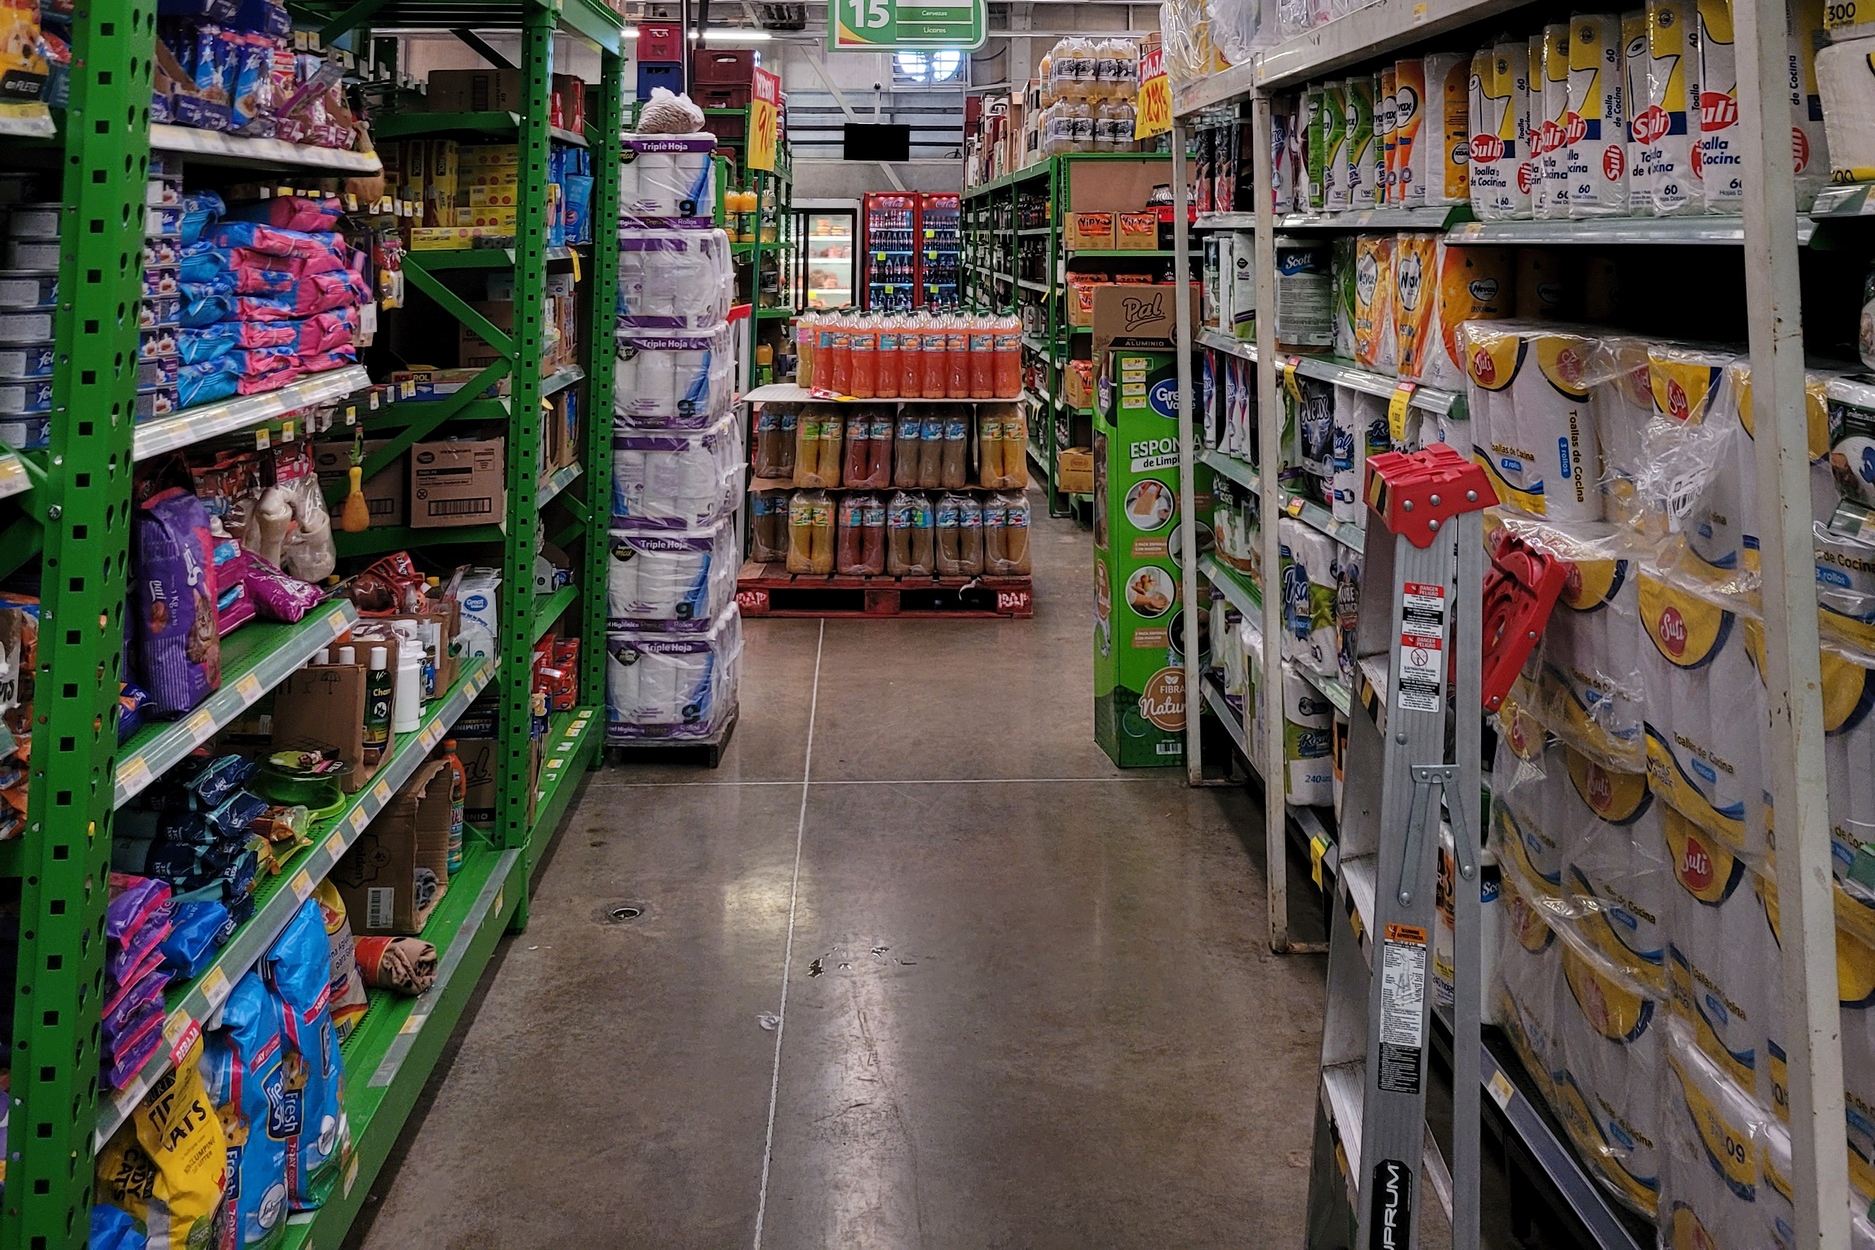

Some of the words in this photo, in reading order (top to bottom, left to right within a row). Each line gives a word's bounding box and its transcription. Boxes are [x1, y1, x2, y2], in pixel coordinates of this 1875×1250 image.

[1827, 1, 1856, 22] 300
[1606, 48, 1616, 63] 60
[1789, 54, 1797, 90] Cocina
[1605, 94, 1613, 119] Toalla
[1613, 86, 1622, 114] Cocina
[1691, 83, 1699, 111] Toalla
[1568, 118, 1583, 138] uli
[1614, 116, 1622, 128] de
[642, 142, 667, 151] Triple
[668, 142, 689, 152] Hoja
[1606, 148, 1620, 180] Suli
[1632, 164, 1645, 177] de
[1578, 184, 1591, 194] 60
[1663, 184, 1678, 195] 60
[678, 200, 696, 218] 9
[1284, 253, 1312, 271] Scott
[642, 339, 667, 349] Triple
[668, 339, 688, 350] Hoja
[1125, 339, 1165, 348] ALUMINIO
[1474, 351, 1494, 376] Suli
[1155, 387, 1196, 402] Gret
[1667, 386, 1687, 413] Suli
[1569, 410, 1579, 448] Toallas
[1143, 458, 1155, 468] de
[1510, 447, 1517, 456] de
[1516, 448, 1536, 463] Cocina
[1561, 451, 1570, 473] rollos
[1573, 450, 1581, 464] de
[1573, 466, 1585, 503] Cocina
[641, 539, 666, 550] Triple
[667, 539, 688, 550] Hoja
[1823, 550, 1835, 564] de
[1837, 553, 1875, 573] Cocina
[1824, 569, 1846, 584] rollos
[675, 602, 693, 621] 9
[1660, 616, 1685, 642] Suli
[672, 643, 693, 654] Hoja
[1159, 685, 1186, 694] FIBRA
[681, 704, 701, 724] 9
[1708, 748, 1735, 775] Cocina
[1304, 774, 1322, 784] 240
[1682, 853, 1708, 876] Suli
[1482, 881, 1500, 896] Sco
[176, 1027, 200, 1063] REBAJA
[283, 1092, 299, 1132] Fresh
[288, 1142, 297, 1168] 7-DAY
[114, 1147, 143, 1202] CATS
[227, 1150, 238, 1199] Fresh
[1383, 1163, 1400, 1250] PRUM
